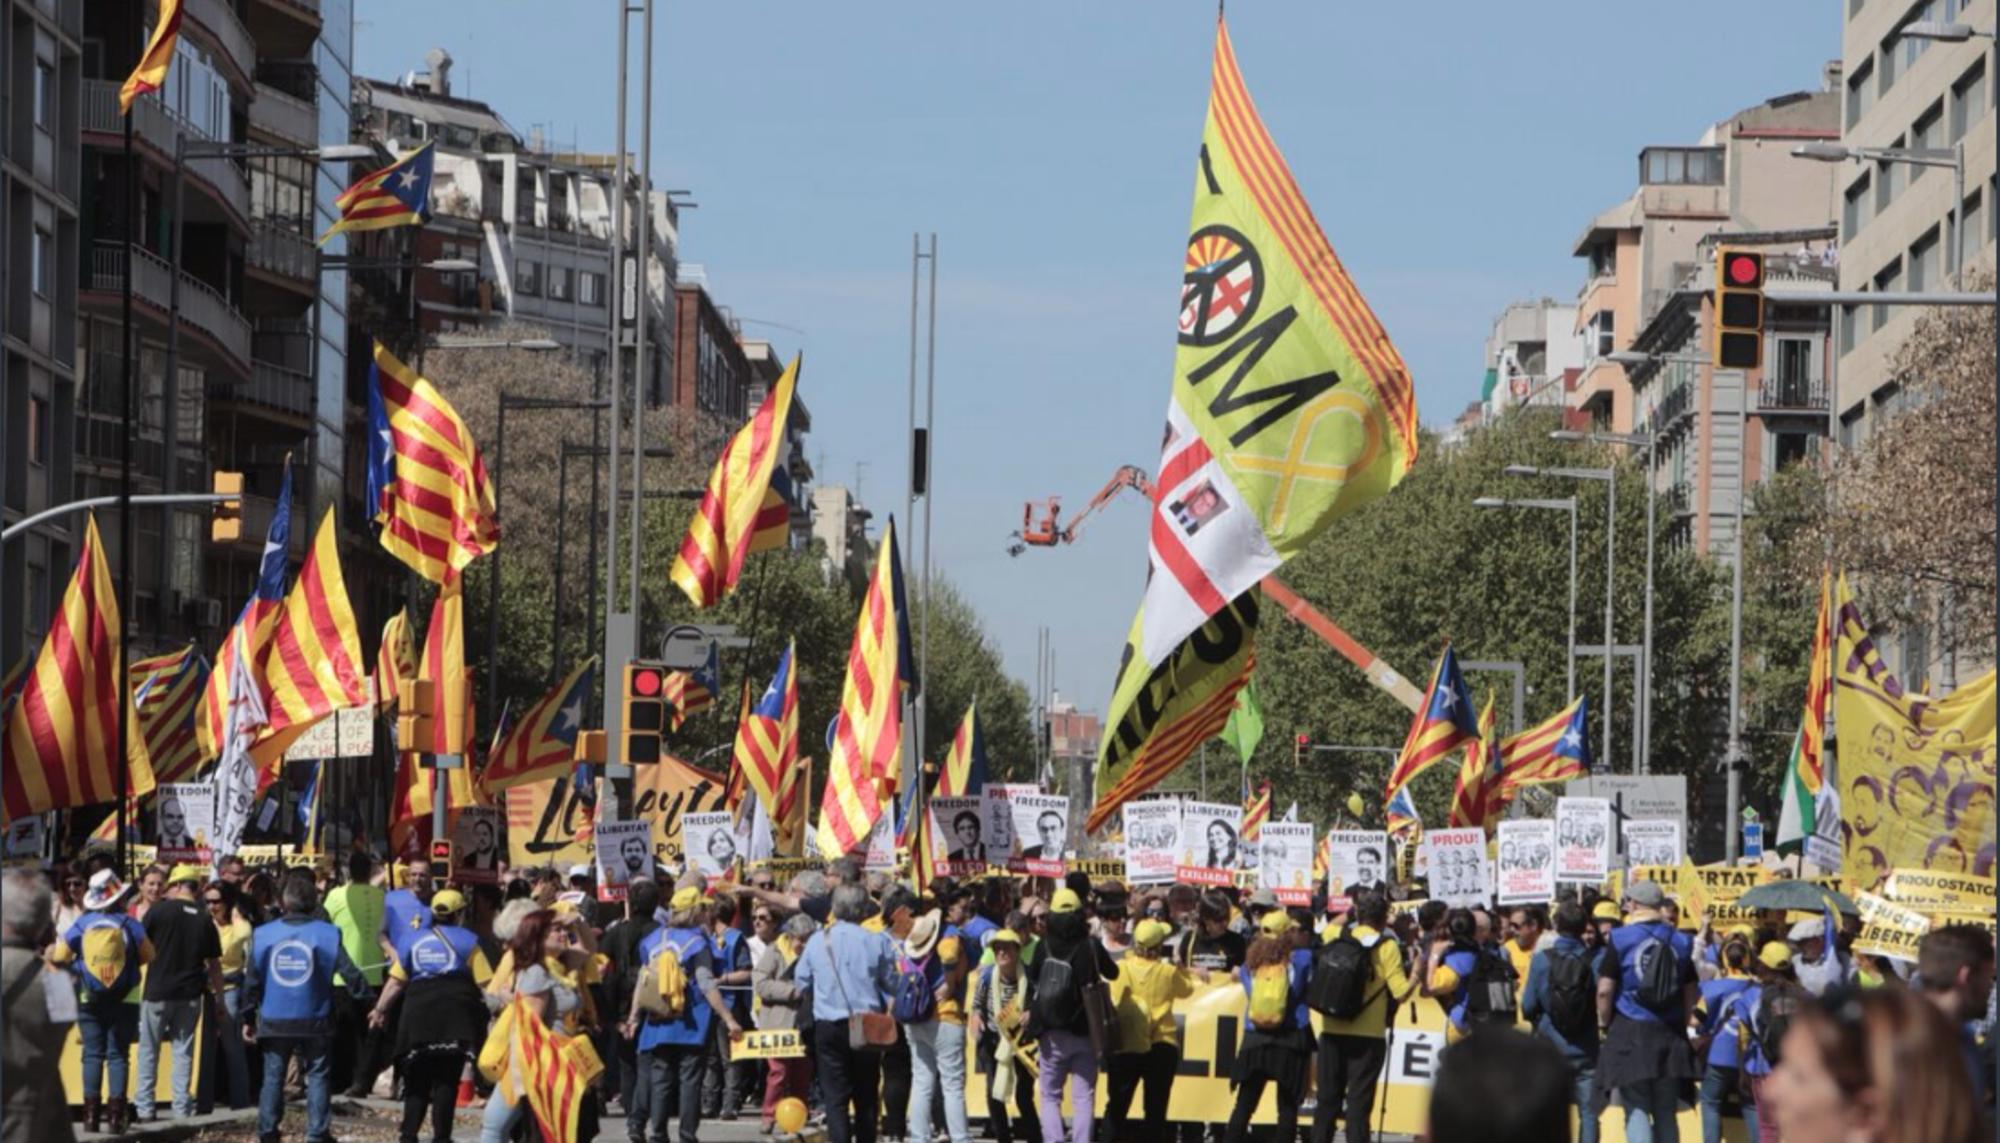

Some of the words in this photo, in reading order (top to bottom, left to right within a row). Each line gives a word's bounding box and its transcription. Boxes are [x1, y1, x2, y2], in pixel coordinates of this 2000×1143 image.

[160, 786, 212, 796] FREEDOM
[931, 798, 980, 808] FREEDOM
[1015, 796, 1066, 809] FREEDOM
[1187, 805, 1239, 818] LLIBERTAT
[683, 815, 731, 826] FREEDOM
[597, 823, 648, 834] LLIBERTAT
[1262, 826, 1310, 836] LLIBERTAT
[1332, 834, 1384, 843] FREEDOM
[1432, 832, 1480, 847] PROU!
[936, 861, 984, 875] EXILED
[1649, 869, 1758, 886] LLIERTAT
[1896, 874, 1935, 888] PROU
[748, 1033, 803, 1049] LLIB
